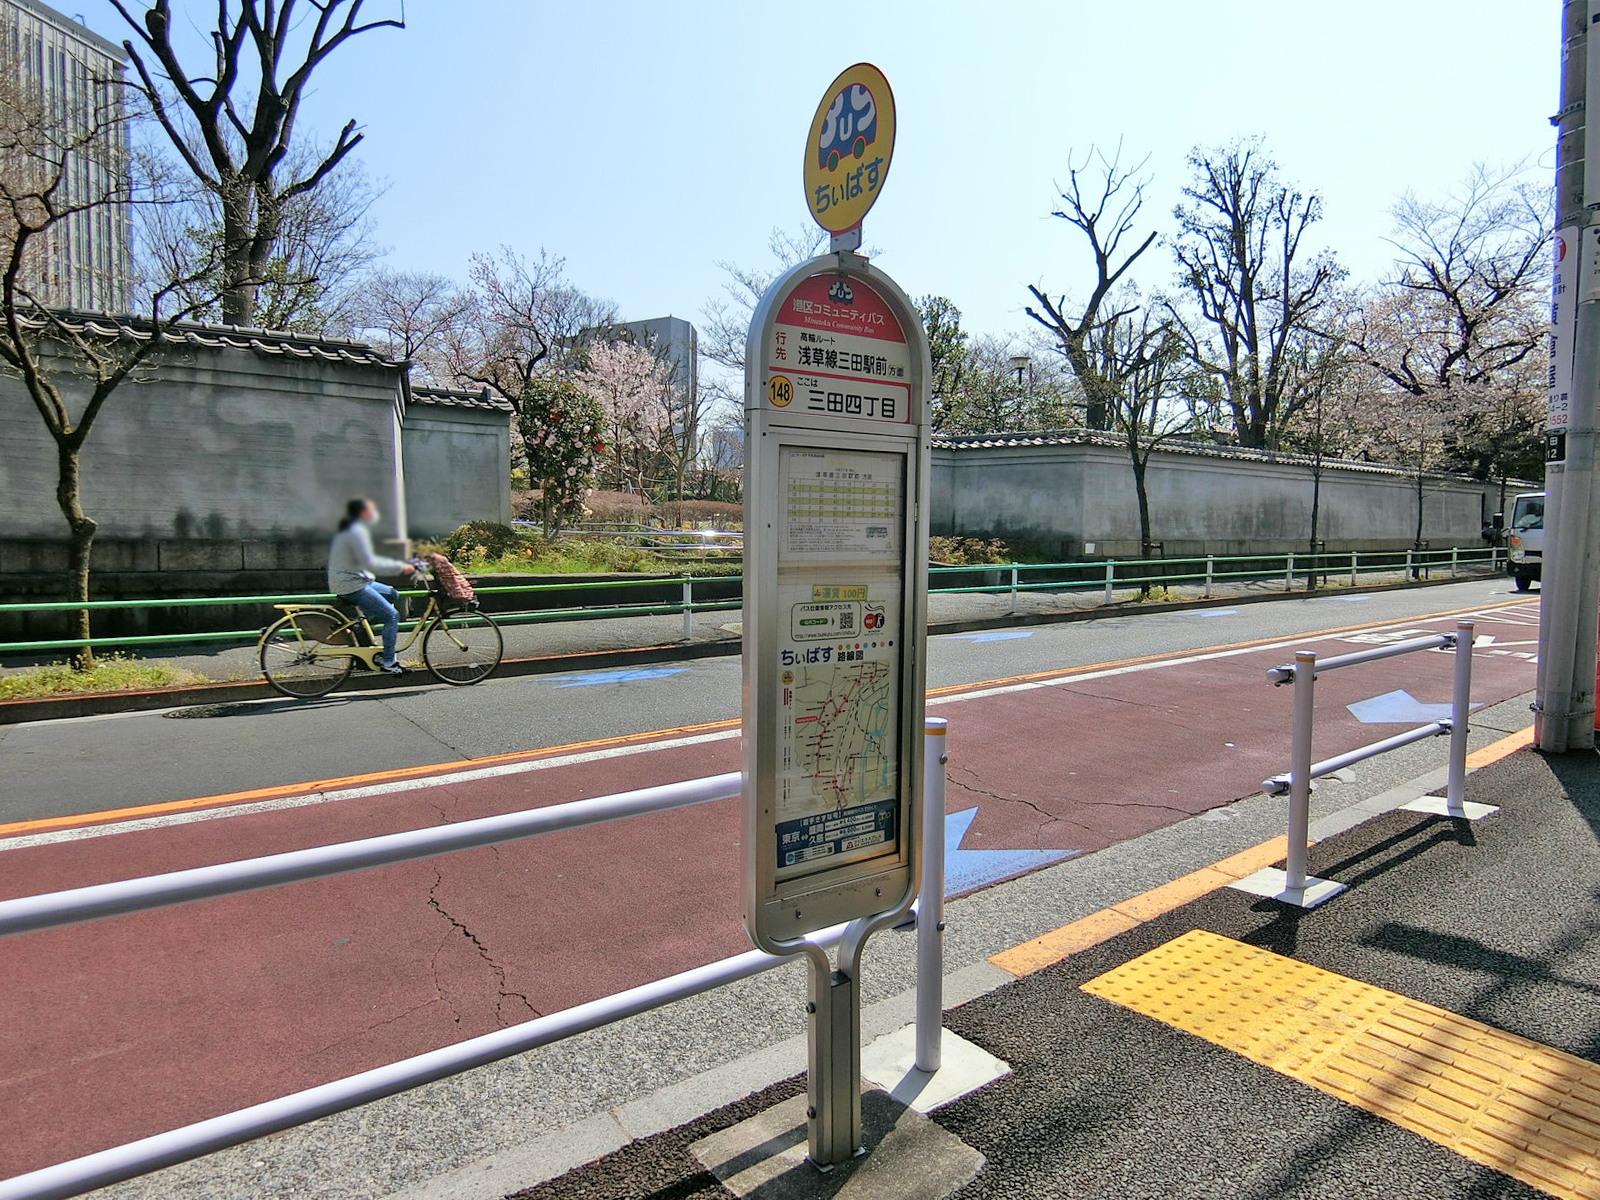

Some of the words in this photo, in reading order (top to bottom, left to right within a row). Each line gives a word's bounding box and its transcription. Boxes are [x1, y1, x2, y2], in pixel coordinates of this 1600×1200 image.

[793, 298, 885, 326] 港区コミュニティバス
[775, 331, 787, 361] 行先
[800, 332, 836, 346] 高輪ルート
[796, 377, 818, 388] ここは
[770, 381, 790, 402] 148
[807, 389, 896, 419] 三田四丁目
[843, 587, 865, 599] 100円
[837, 650, 864, 662] 路線図
[782, 831, 801, 845] 東京
